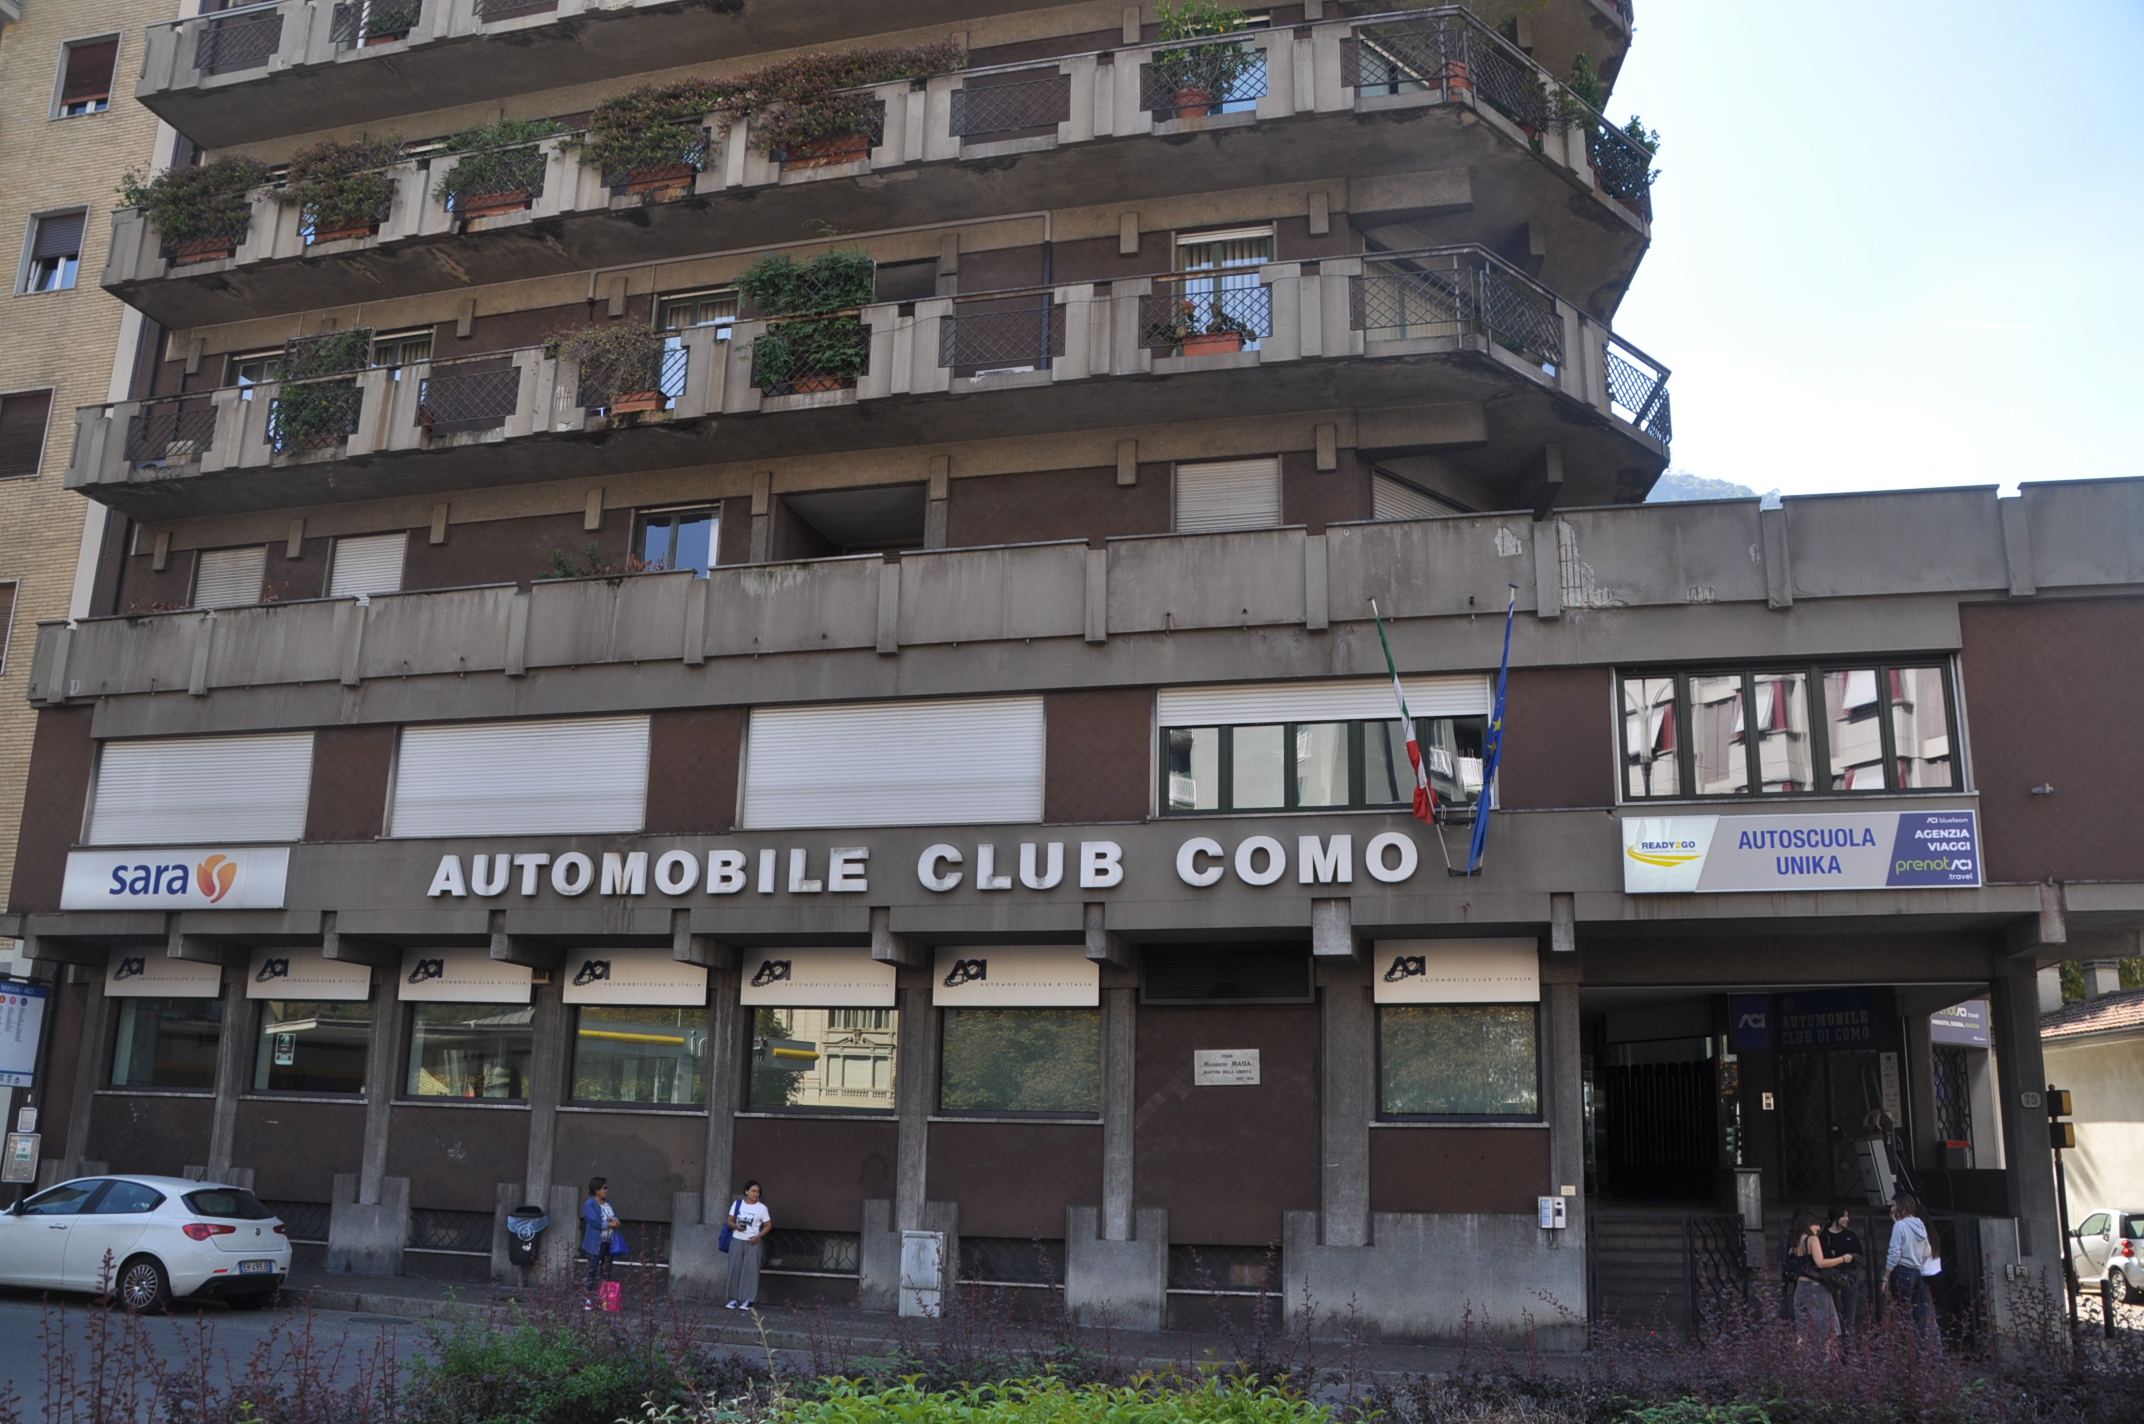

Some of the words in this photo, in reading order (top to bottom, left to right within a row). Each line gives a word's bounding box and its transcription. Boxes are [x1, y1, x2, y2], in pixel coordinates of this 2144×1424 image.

[1939, 816, 1969, 824] blueteam
[1738, 827, 1876, 850] AUTOSCUOLA
[1914, 828, 1970, 839] AGENZIA
[1641, 840, 1696, 850] READY2GO
[1927, 841, 1971, 851] VIAGGI
[427, 846, 869, 897] AUTOMOBILE
[917, 840, 1124, 892] CLUB
[1176, 831, 1419, 887] COMO
[1775, 855, 1842, 876] UNIKA
[109, 864, 190, 896] sara
[1, 984, 20, 993] MASIA
[1737, 1013, 1766, 1029] ACI
[1782, 1010, 1869, 1029] AUTOMOBILE
[1781, 1031, 1812, 1045] CLUB
[1818, 1029, 1831, 1043] DI
[1835, 1026, 1869, 1042] COMO
[2024, 1094, 2038, 1106] 79
